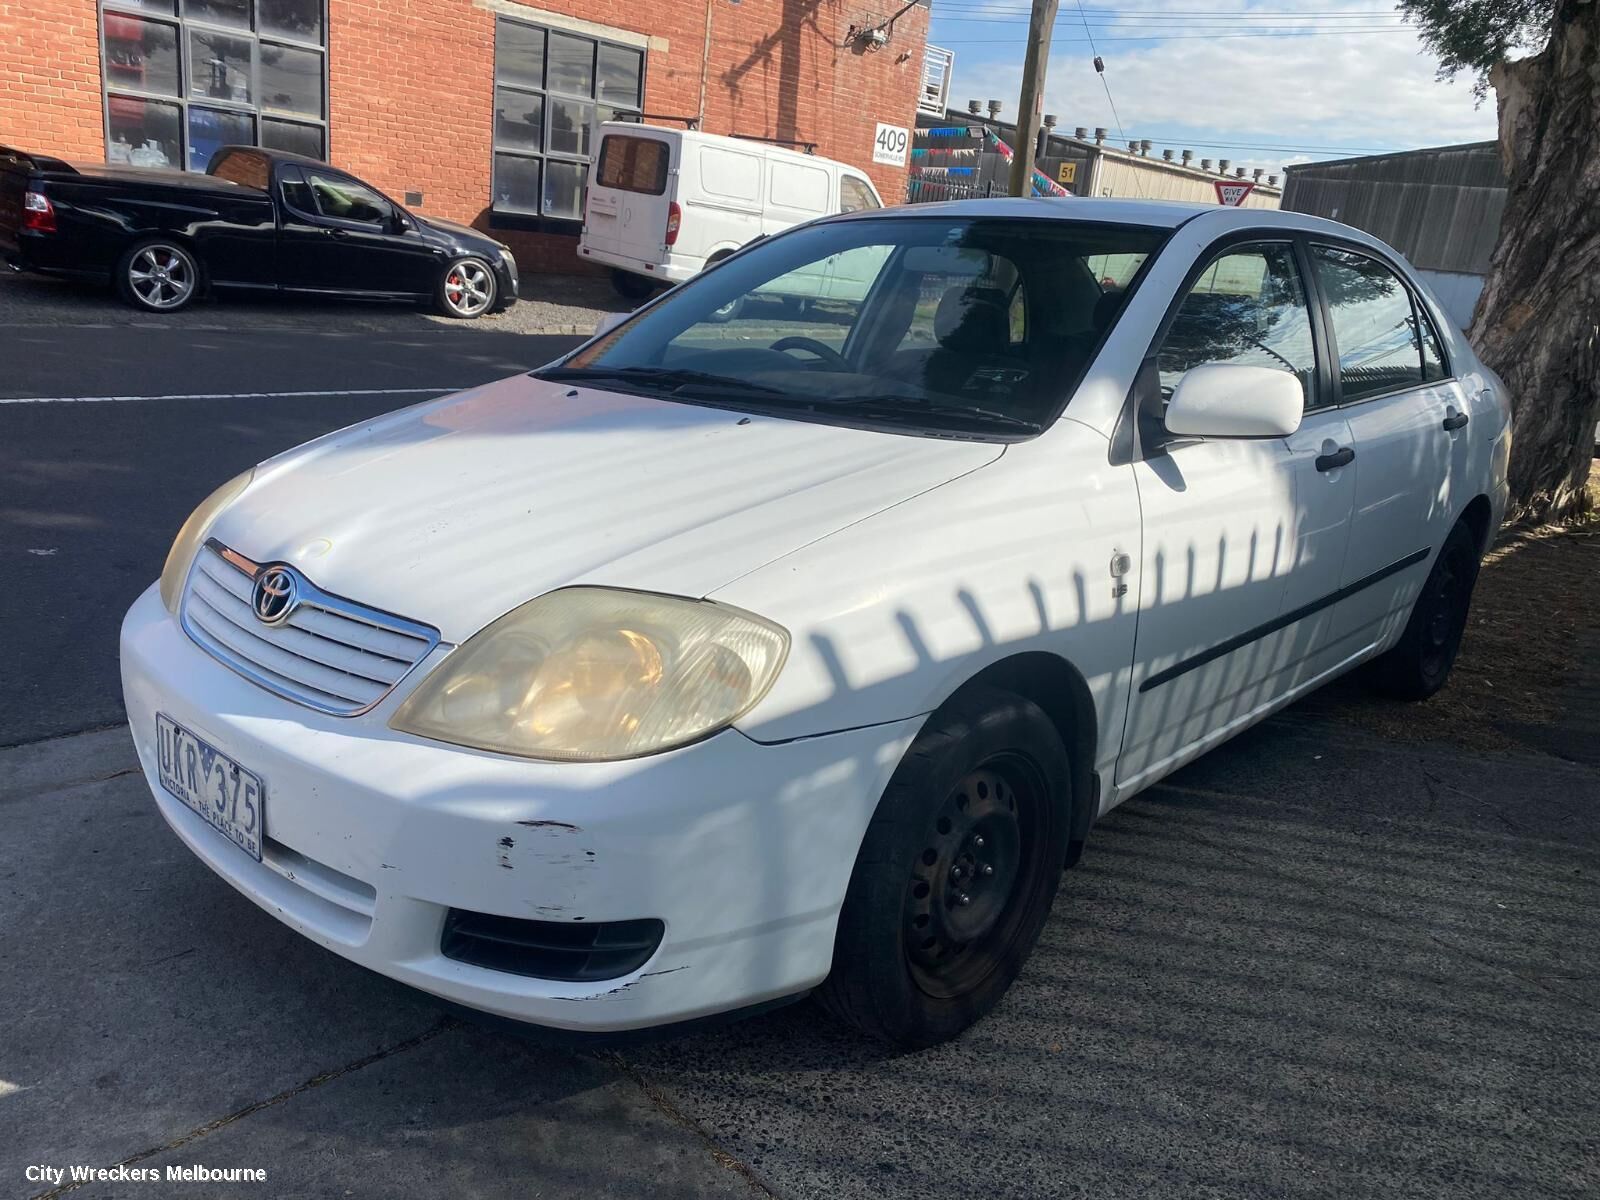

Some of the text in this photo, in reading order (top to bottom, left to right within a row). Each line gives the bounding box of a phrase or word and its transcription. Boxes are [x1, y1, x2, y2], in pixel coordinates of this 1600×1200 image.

[876, 128, 907, 153] 409
[1060, 166, 1074, 179] 51
[1102, 187, 1113, 198] 51
[1223, 187, 1242, 196] GIVE
[159, 724, 256, 835] UKR 375
[163, 776, 190, 801] VICTORIA
[199, 800, 210, 818] THE
[212, 812, 232, 835] PLACE
[235, 828, 244, 844] TO
[247, 838, 256, 854] BE
